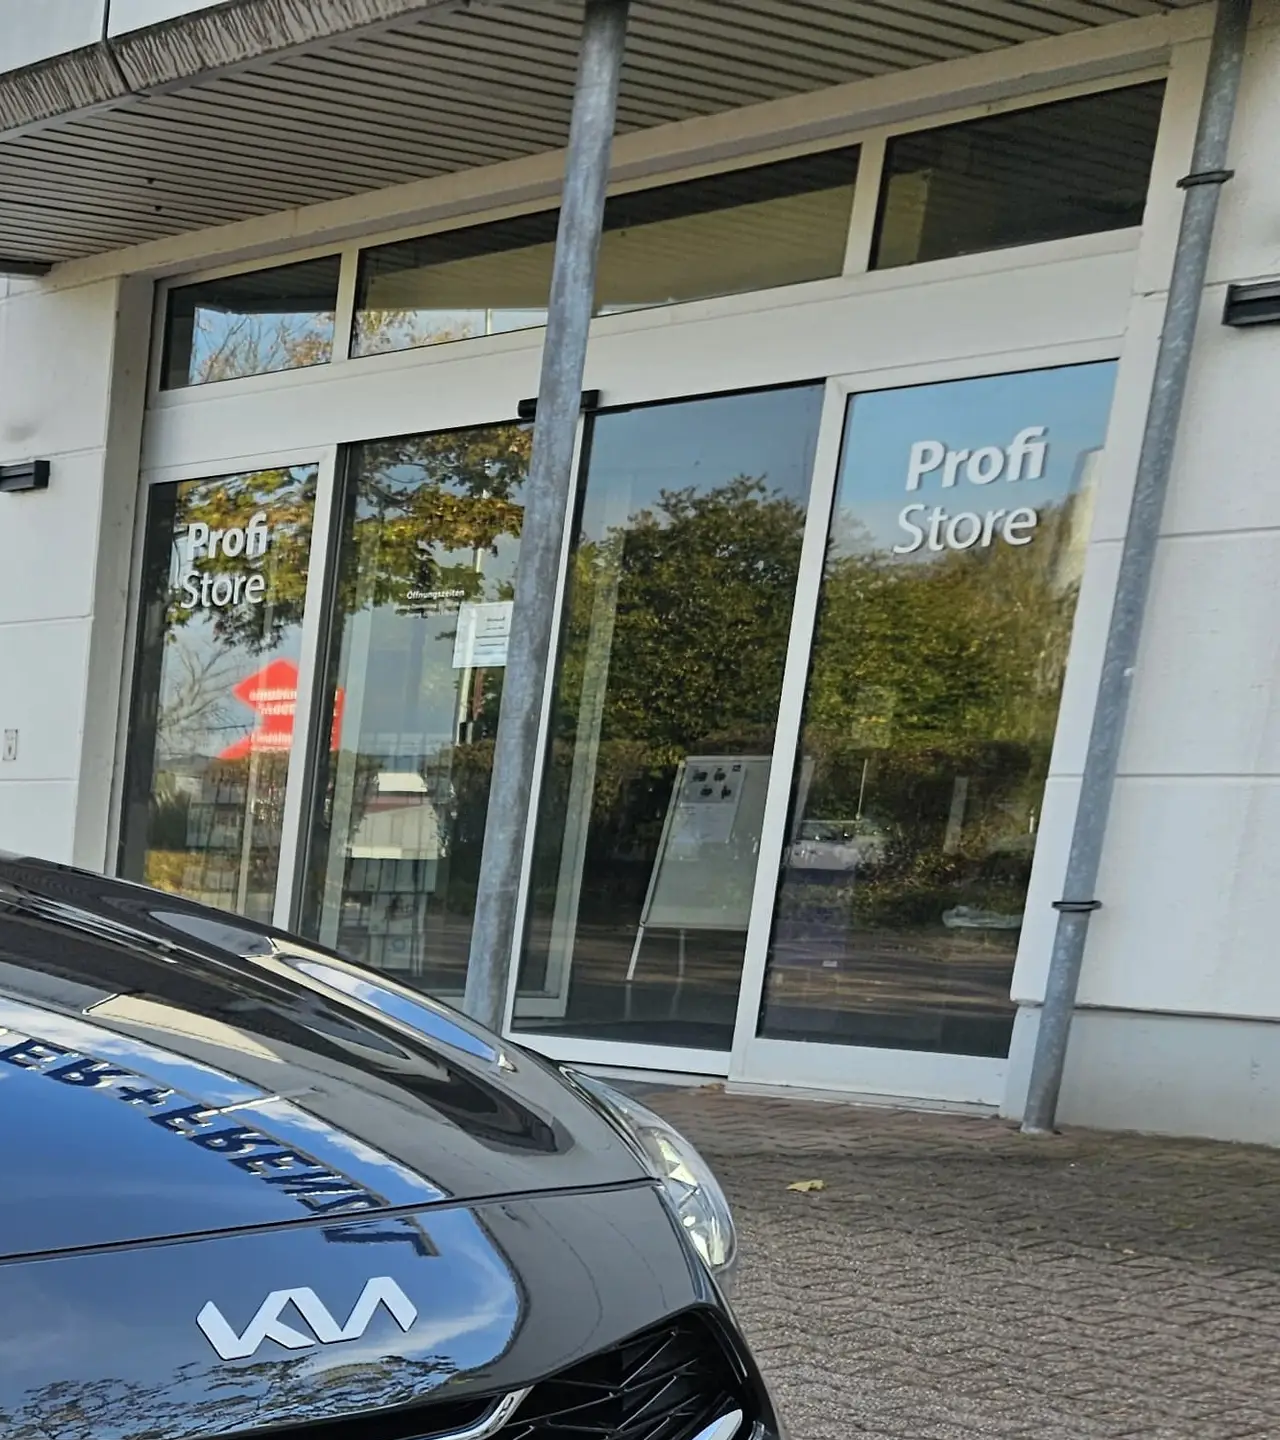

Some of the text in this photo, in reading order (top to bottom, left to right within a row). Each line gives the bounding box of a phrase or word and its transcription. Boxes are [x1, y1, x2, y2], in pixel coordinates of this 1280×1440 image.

[905, 426, 1049, 492] Profi
[187, 511, 269, 561] Profi
[893, 503, 1039, 554] Store
[180, 570, 266, 609] Store
[196, 1276, 418, 1360] KIA
